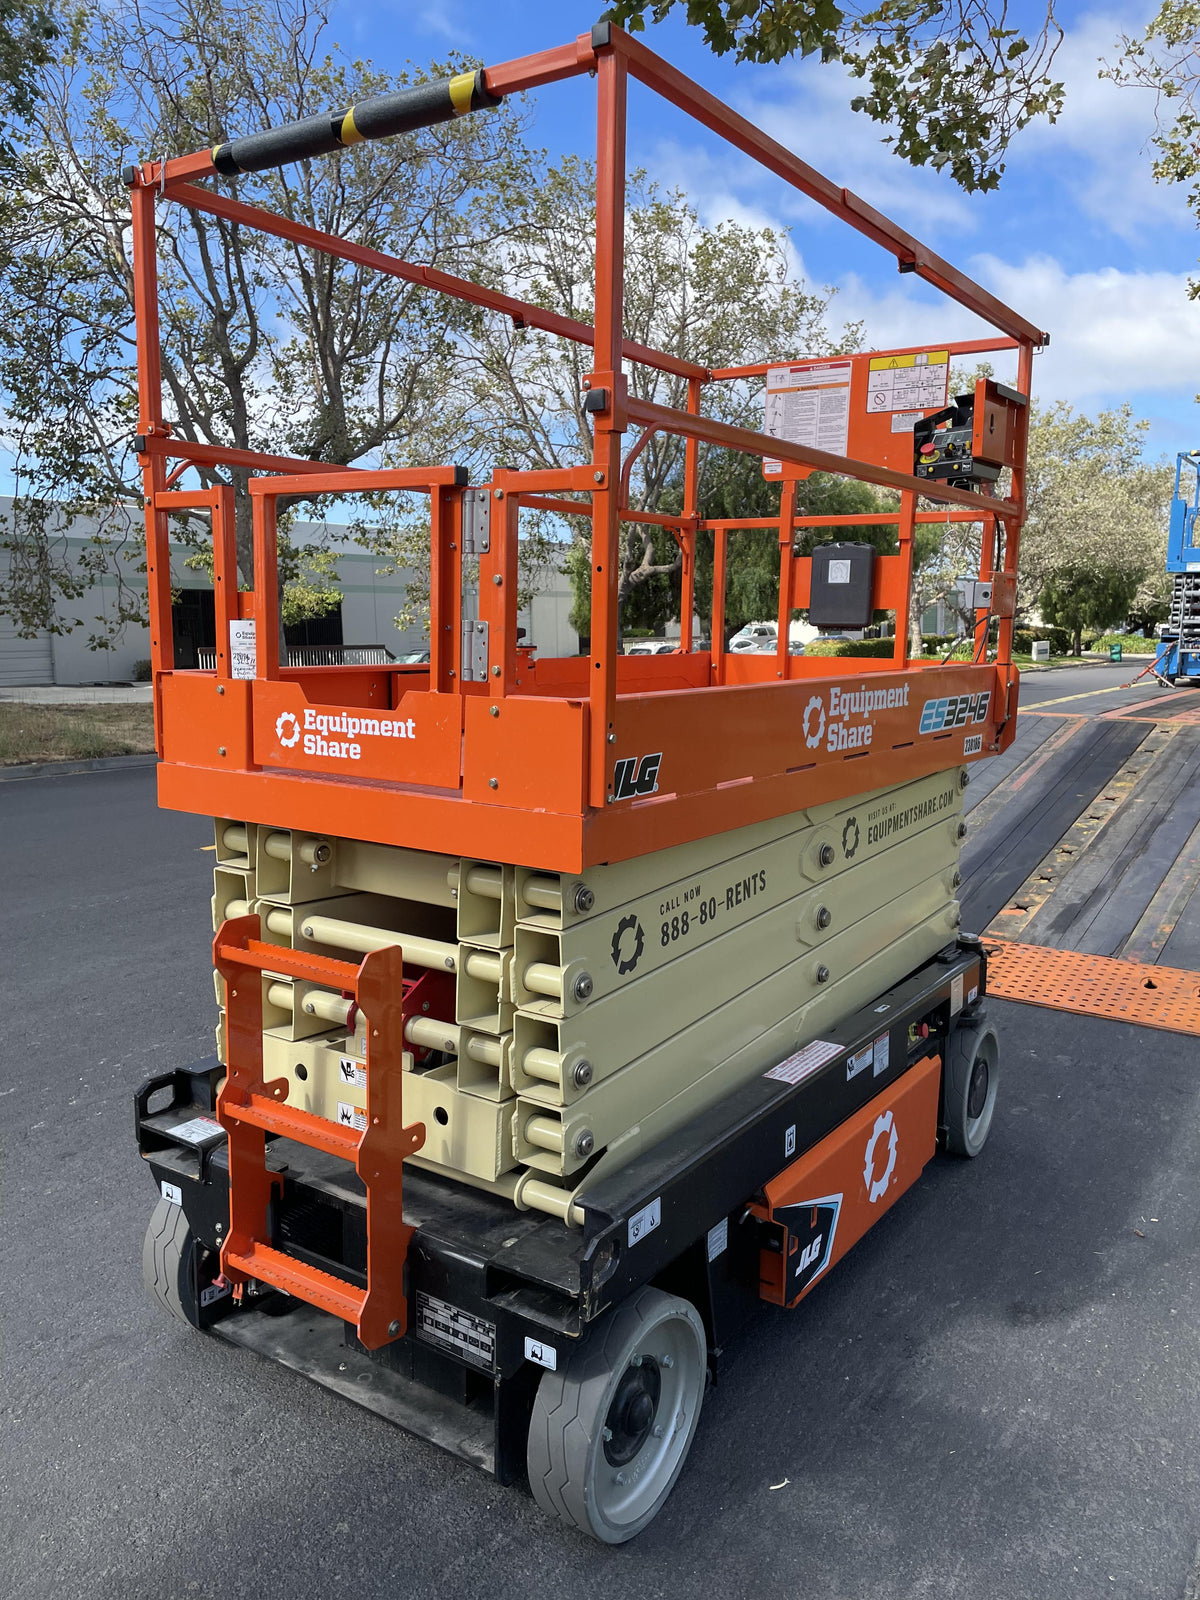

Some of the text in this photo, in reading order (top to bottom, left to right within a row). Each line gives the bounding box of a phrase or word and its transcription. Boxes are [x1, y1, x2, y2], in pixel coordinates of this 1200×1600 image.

[829, 682, 910, 721] Equipment
[919, 691, 991, 734] ES3246
[303, 708, 416, 739] Equipment
[827, 722, 873, 752] Share
[303, 734, 361, 760] Share
[867, 810, 881, 822] VISIT
[882, 805, 888, 815] US
[867, 789, 954, 845] EQUIPMENTSHARE.COM
[660, 885, 701, 915] CALL NOW
[661, 869, 766, 947] 888-80-RENTS
[795, 1233, 823, 1278] JLG
